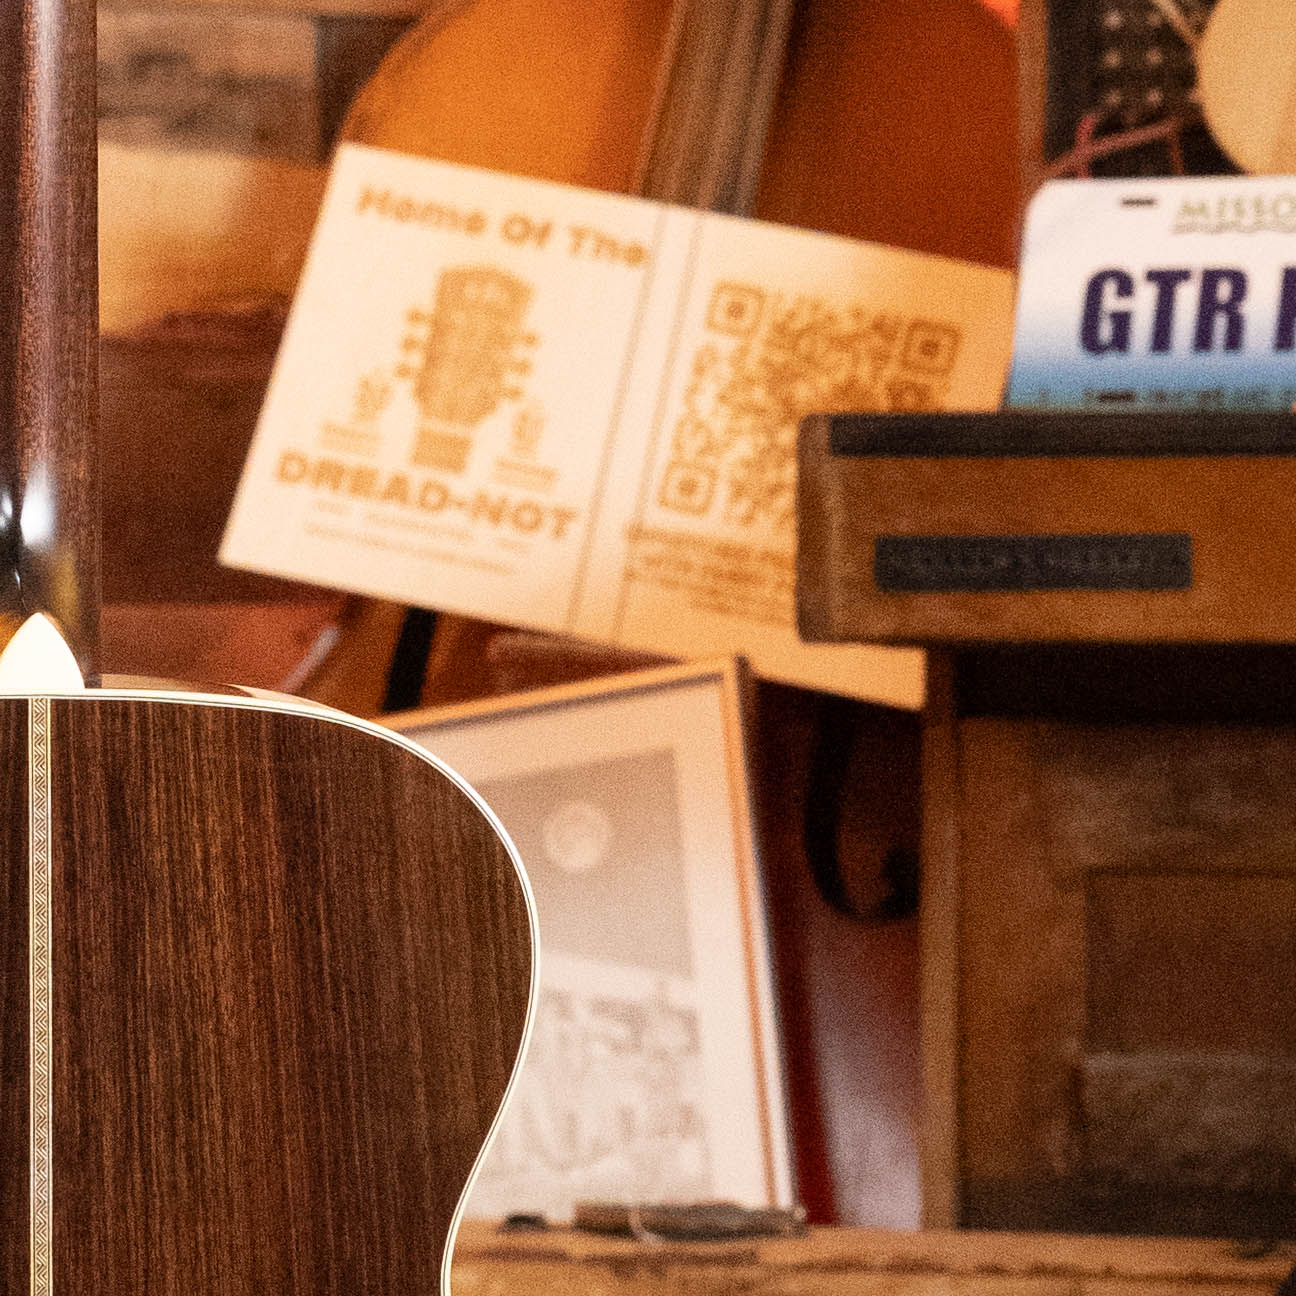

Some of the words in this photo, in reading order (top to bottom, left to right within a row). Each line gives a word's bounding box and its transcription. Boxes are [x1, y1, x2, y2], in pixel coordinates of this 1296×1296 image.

[358, 184, 486, 236] Home
[501, 213, 552, 249] Of
[568, 225, 650, 268] The
[1079, 267, 1249, 356] GTR
[276, 450, 578, 540] DREAD-NOT
